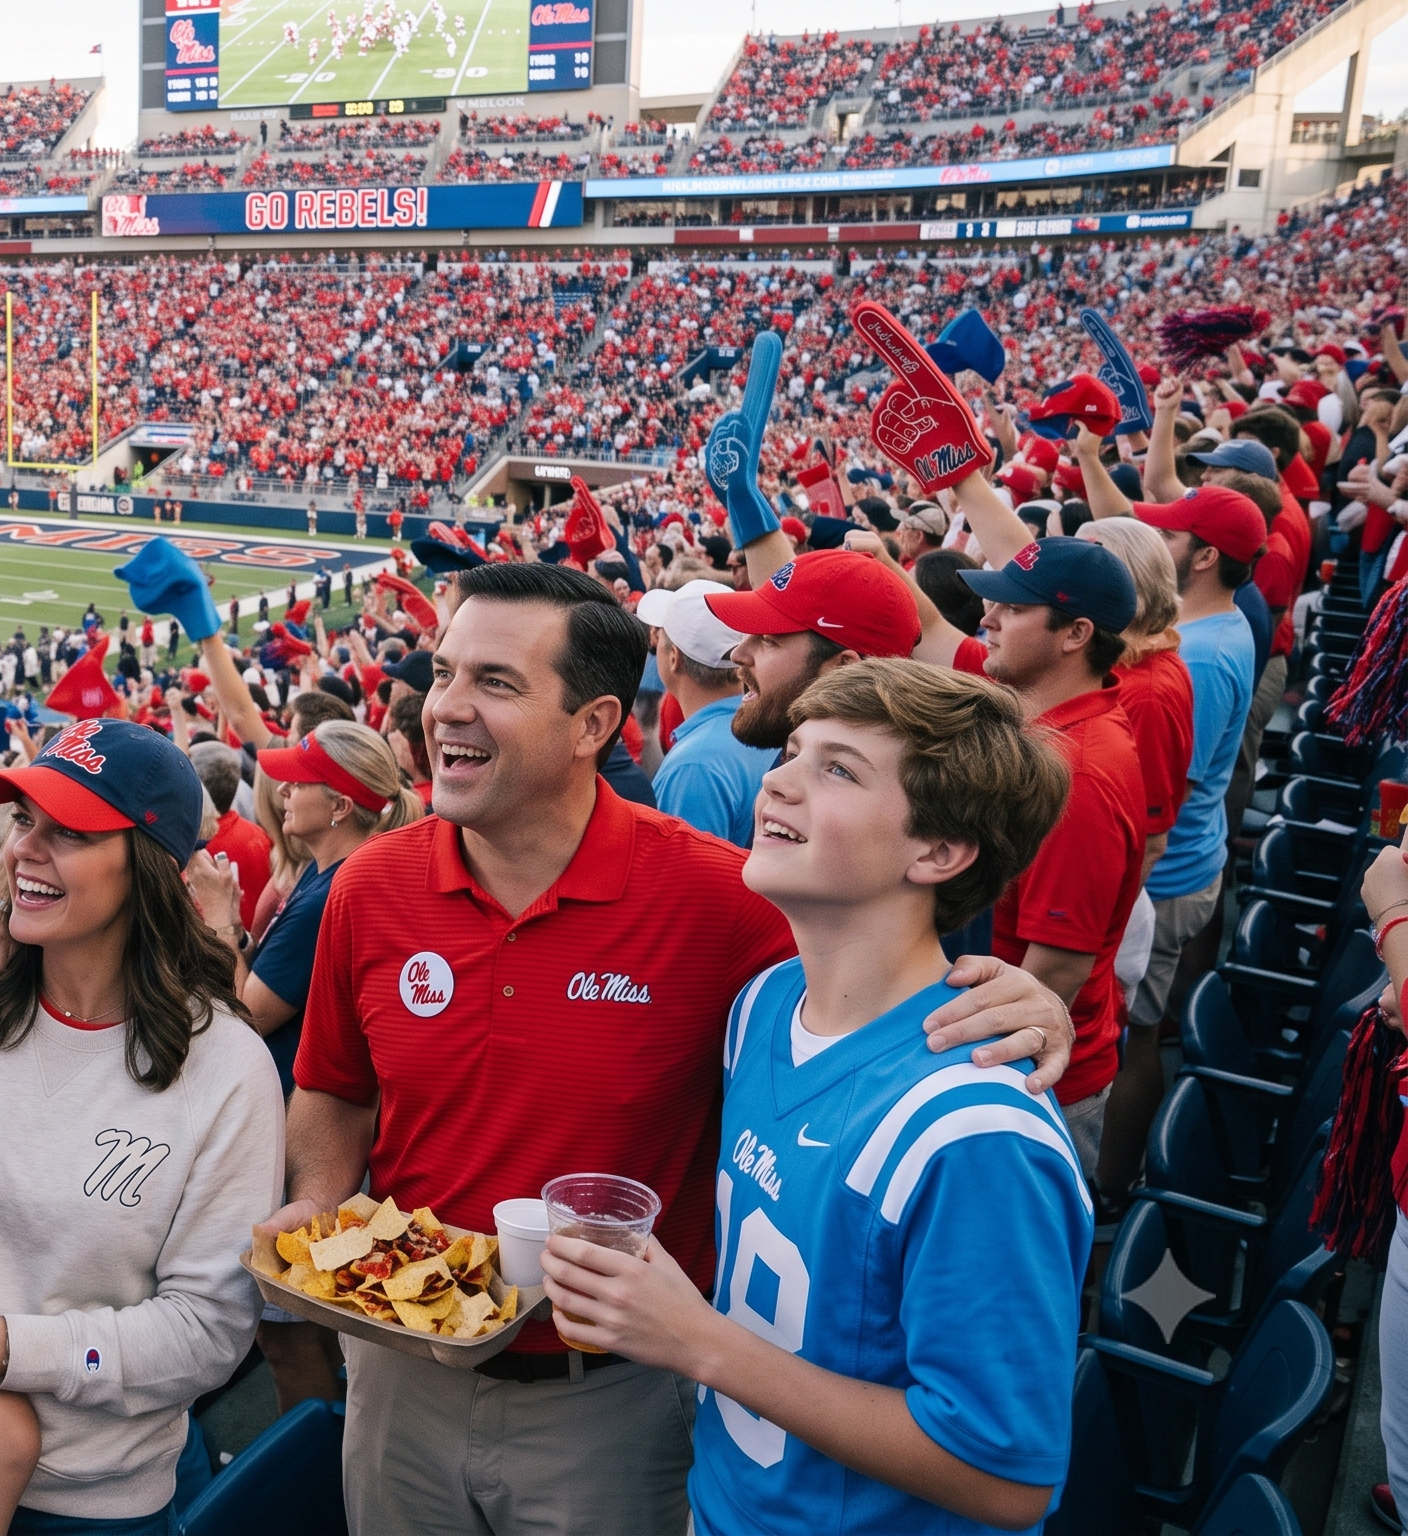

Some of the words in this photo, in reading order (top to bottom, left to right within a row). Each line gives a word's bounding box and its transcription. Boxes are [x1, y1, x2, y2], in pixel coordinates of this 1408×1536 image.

[245, 192, 289, 230] GO
[295, 187, 428, 229] REBELS!
[931, 442, 977, 475] Miss
[407, 961, 430, 983] Ole
[566, 971, 601, 1001] Ole
[599, 972, 653, 1004] Miss
[411, 984, 447, 1005] Miss
[83, 1128, 171, 1207] M
[732, 1128, 753, 1175] Ole
[750, 1144, 780, 1201] Miss
